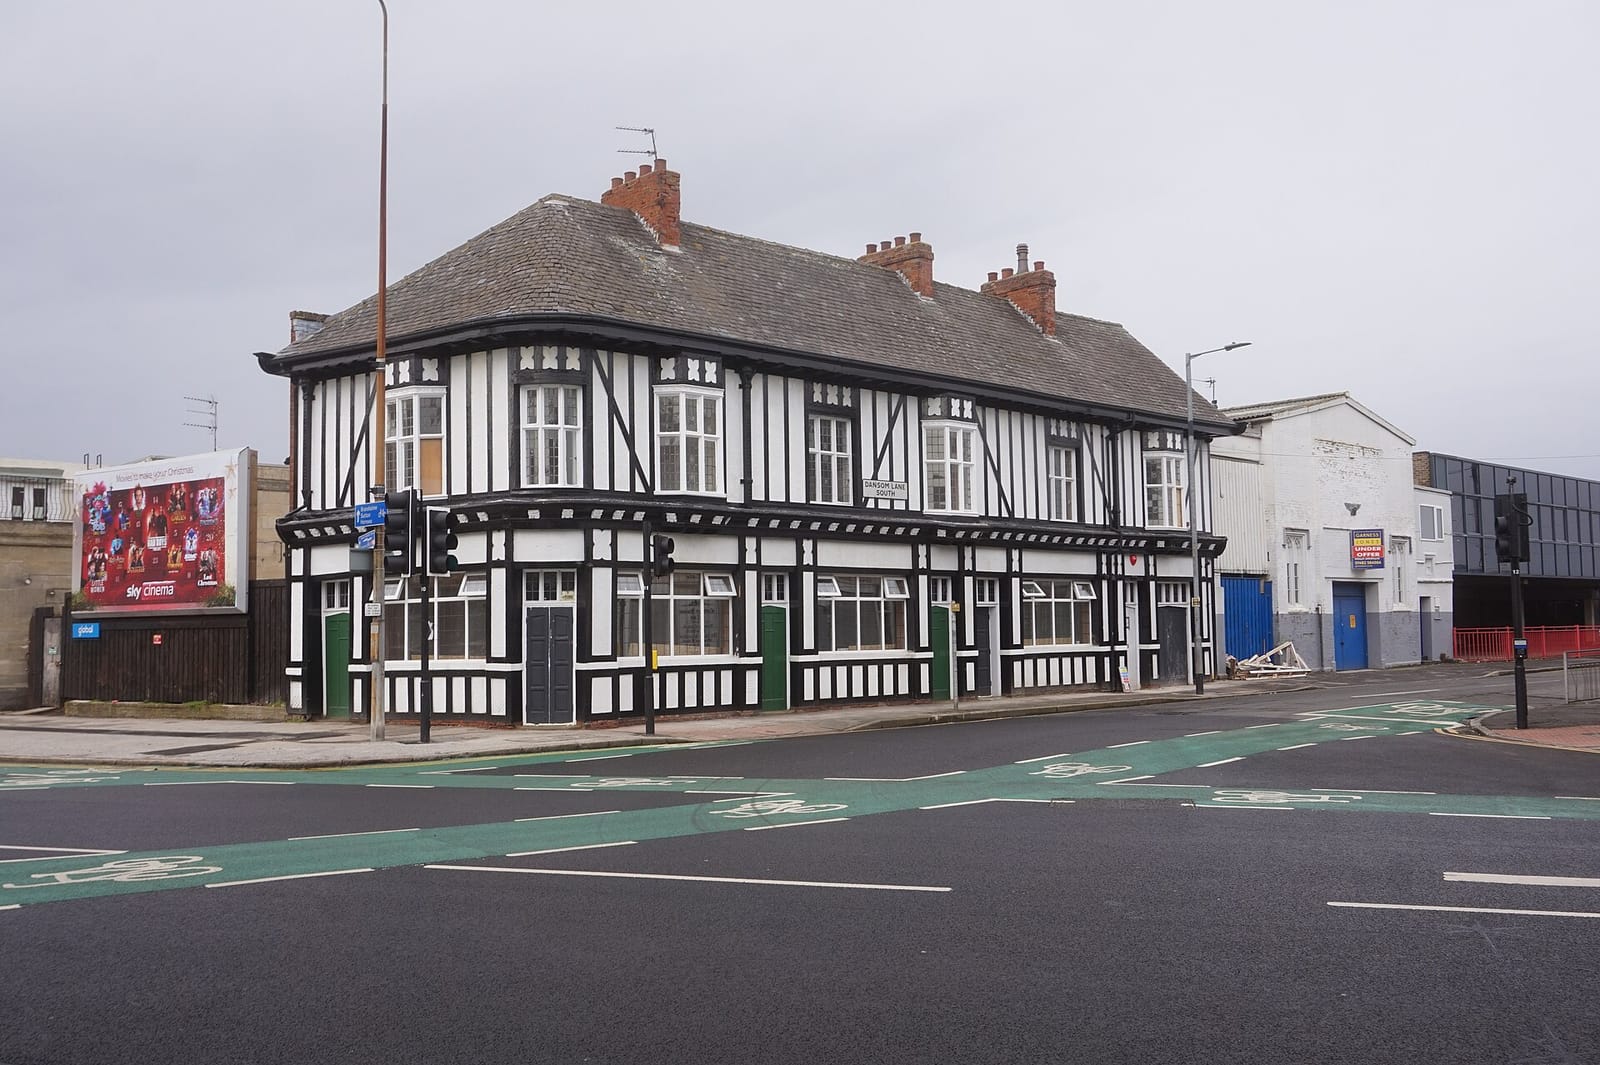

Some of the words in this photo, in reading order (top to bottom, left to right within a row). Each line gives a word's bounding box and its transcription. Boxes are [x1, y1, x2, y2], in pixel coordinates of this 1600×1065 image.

[139, 471, 153, 480] make
[152, 470, 168, 482] your
[168, 467, 194, 477] Christmas
[126, 585, 142, 600] sky
[143, 585, 175, 597] cinema
[78, 625, 93, 636] global
